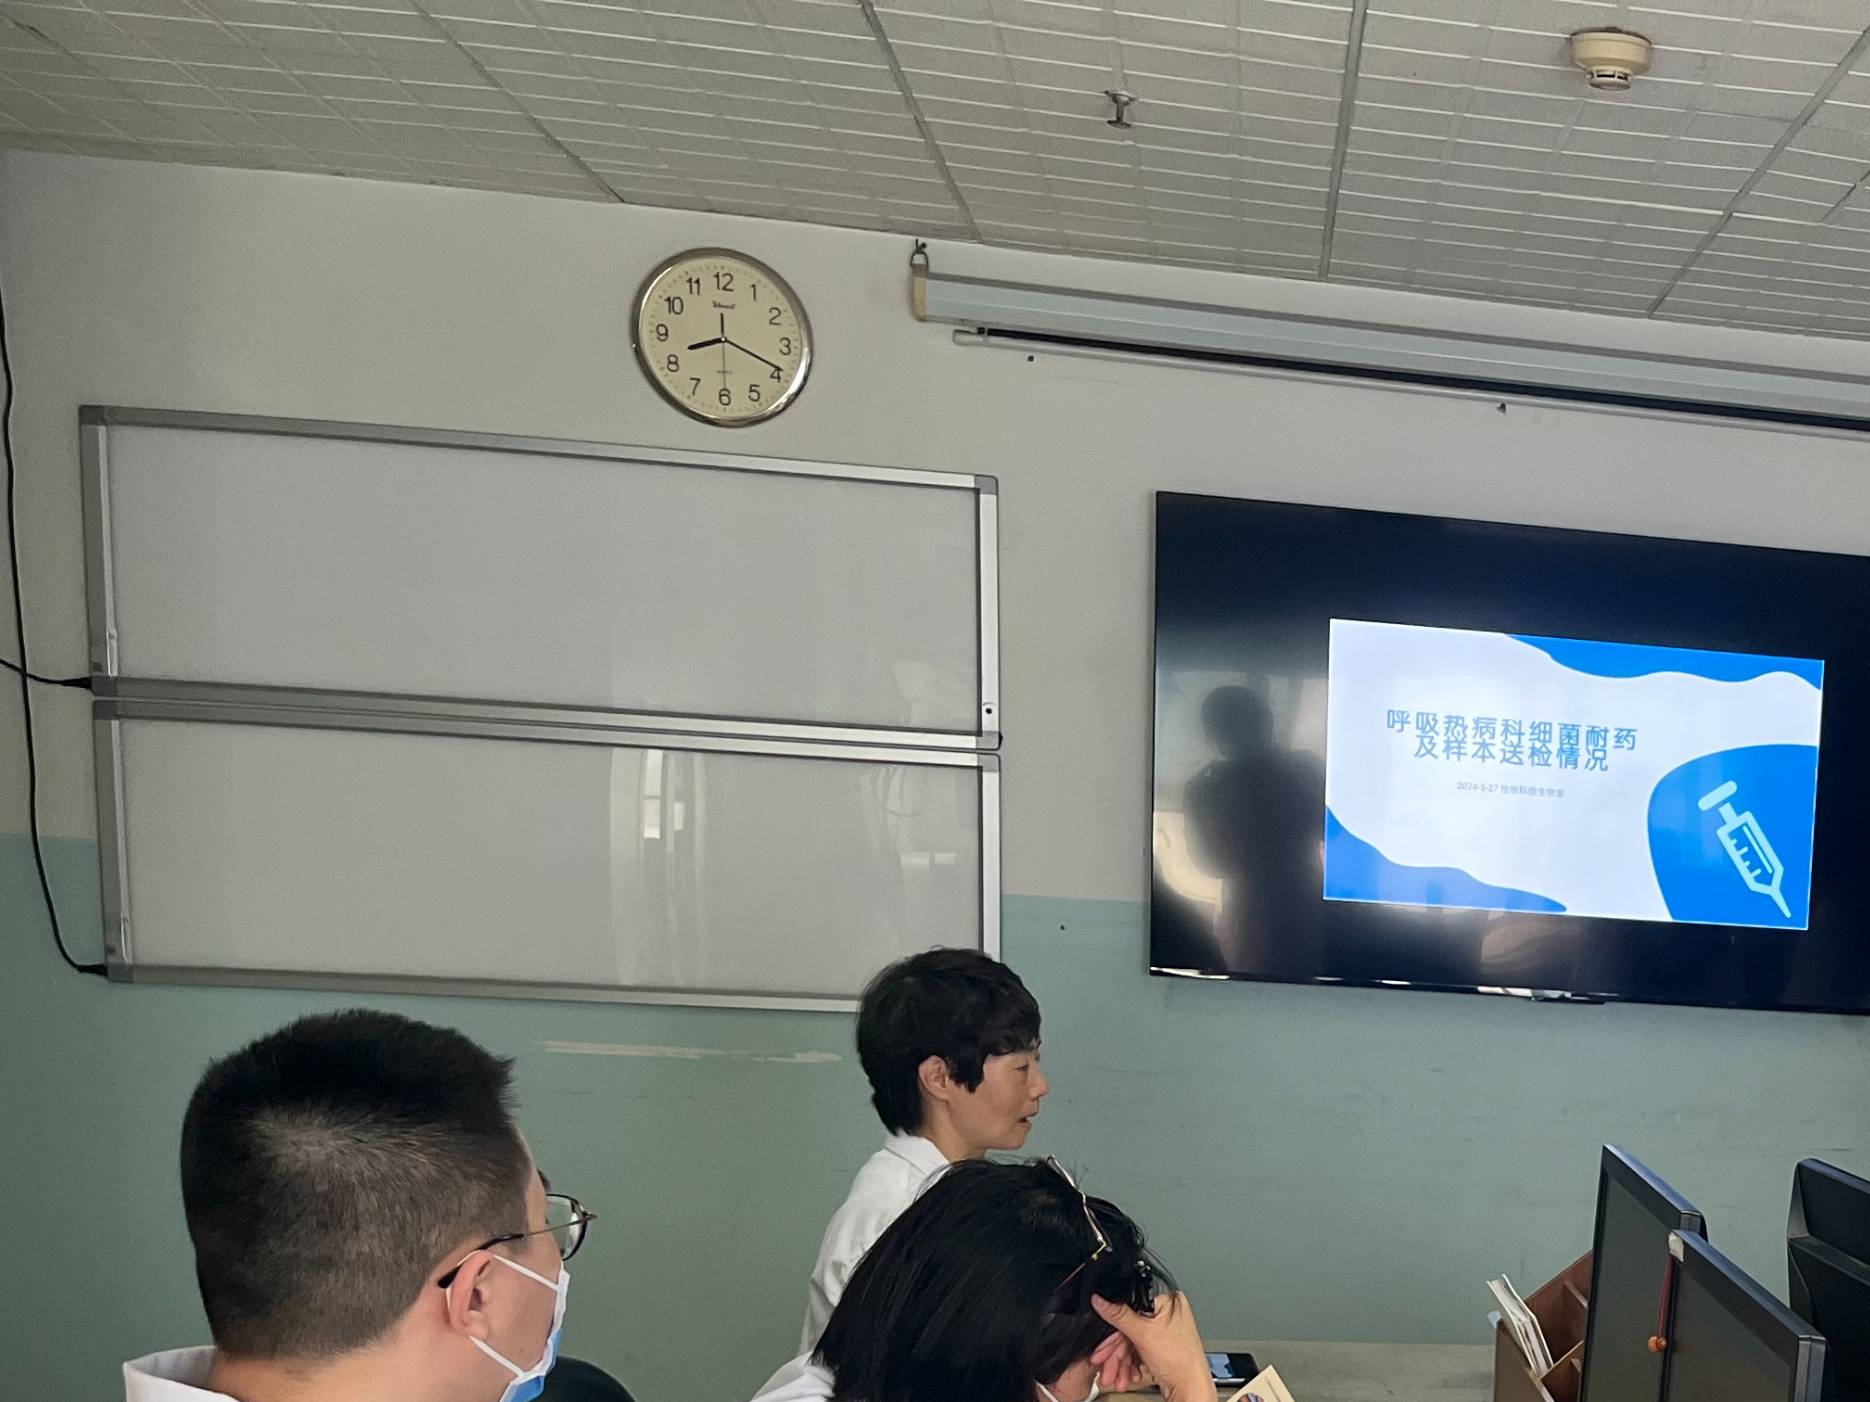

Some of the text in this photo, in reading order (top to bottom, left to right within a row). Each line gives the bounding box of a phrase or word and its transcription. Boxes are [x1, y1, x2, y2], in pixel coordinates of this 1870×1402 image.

[686, 277, 701, 296] 11
[713, 272, 734, 292] 12
[750, 284, 757, 301] 1
[664, 296, 684, 315] 10
[769, 307, 782, 326] 2
[655, 324, 669, 342] 9
[779, 337, 792, 356] 3
[666, 354, 680, 372] 8
[769, 367, 783, 383] 4
[689, 377, 701, 396] 7
[748, 384, 761, 402] 5
[718, 388, 731, 406] 6
[1386, 709, 1638, 751] 呼吸热病科细菌耐药
[1414, 734, 1609, 772] 及样本送检情况
